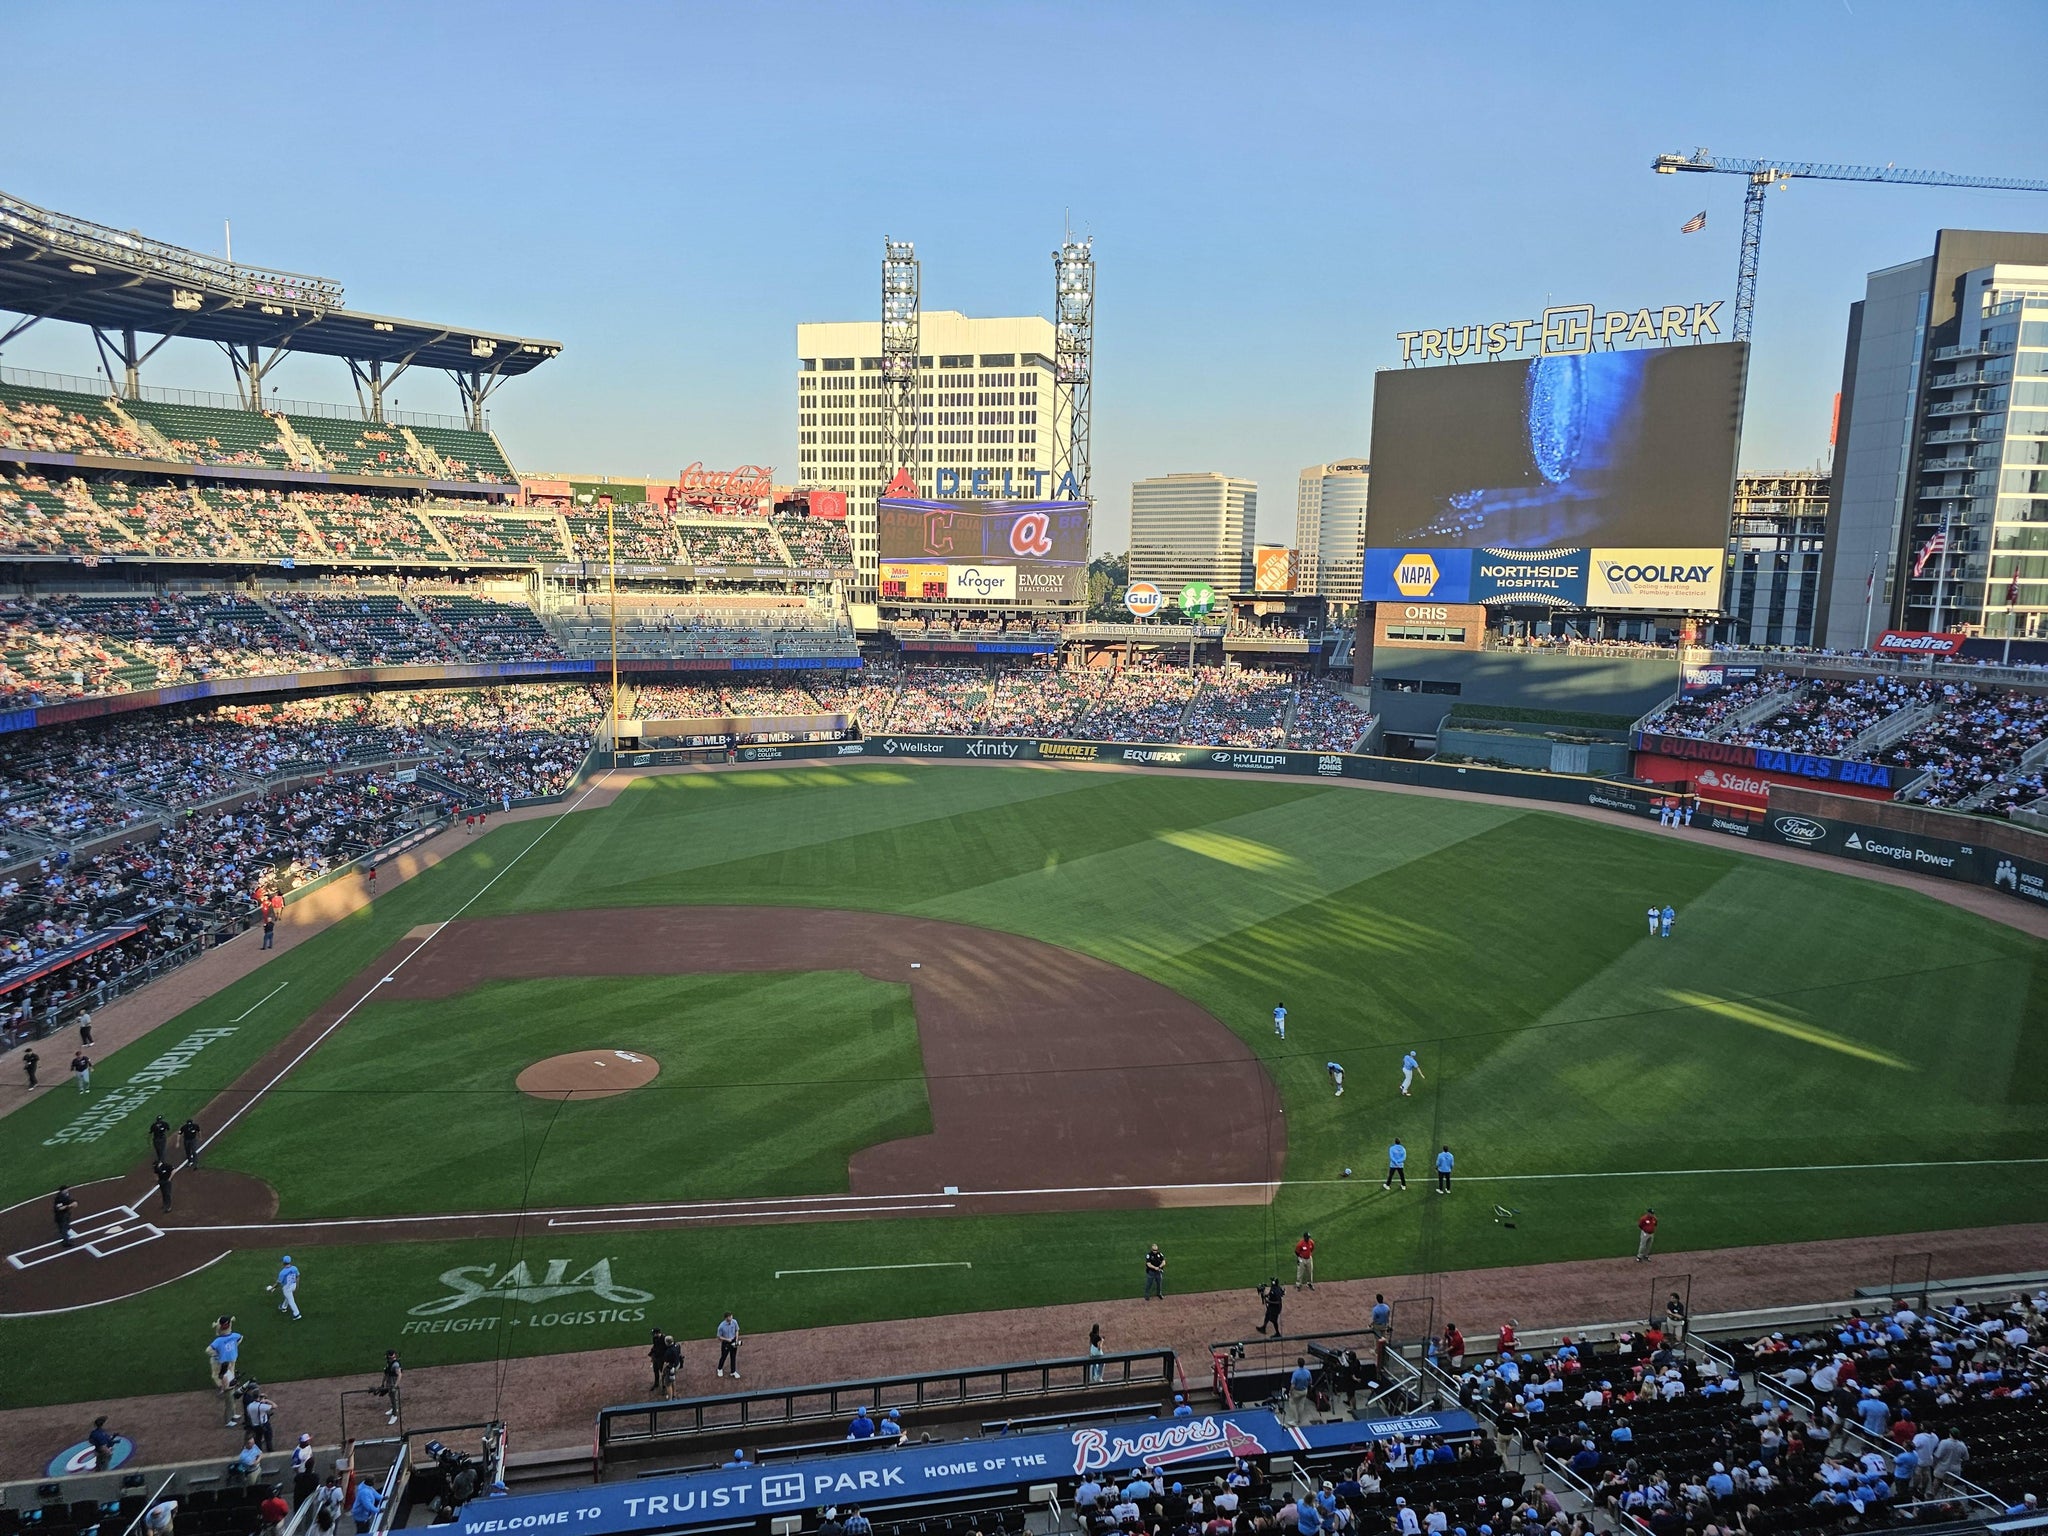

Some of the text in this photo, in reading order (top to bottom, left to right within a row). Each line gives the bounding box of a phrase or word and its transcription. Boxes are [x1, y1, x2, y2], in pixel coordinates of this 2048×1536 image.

[1397, 301, 1725, 361] TRUIST PARK
[936, 468, 1081, 497] DELTA
[1261, 553, 1280, 571] THE
[787, 569, 801, 577] 7:11
[1258, 550, 1298, 590] HOME
[1400, 565, 1432, 585] NAPA
[1480, 566, 1579, 578] NORTHSIDE
[1607, 565, 1714, 583] COOLRAY
[958, 569, 1005, 595] Kroger
[1018, 574, 1066, 586] EMORY
[1496, 579, 1559, 589] HOSPITAL
[1128, 593, 1158, 605] Gulf
[637, 608, 815, 626] HANK AARON TERRACE
[1405, 606, 1448, 620] ORIS
[1880, 634, 1953, 650] RaceTrac
[498, 662, 547, 676] BRAVES
[778, 658, 822, 669] BRAVES
[1686, 669, 1723, 678] BRAVES
[1686, 676, 1723, 685] VISION
[704, 735, 731, 745] MLB+
[768, 733, 795, 743] MLB+
[820, 731, 846, 741] MLB+
[900, 742, 944, 752] Wellstar
[966, 740, 1018, 758] xfinity
[1039, 743, 1098, 756] QUIKRETE
[1123, 749, 1183, 762] EQUIFAX
[1233, 753, 1286, 765] HYUNDAI
[1319, 756, 1342, 765] PAPA
[1317, 763, 1342, 771] JOHNS
[1759, 749, 1832, 778] RAVES
[1839, 759, 1890, 788] BRA
[1719, 820, 1749, 833] National
[1782, 817, 1816, 839] Ford
[1865, 840, 1954, 867] Georgia Power
[407, 1257, 655, 1316] SAIA
[401, 1307, 646, 1335] FREIGHT LOGISTICS
[1373, 1419, 1435, 1434] BRAVES.COM
[465, 1511, 569, 1535] WELCOME
[576, 1507, 602, 1520] TO
[623, 1484, 753, 1518] TRUIST
[814, 1466, 905, 1495] PARK
[924, 1461, 978, 1478] HOME
[985, 1458, 1008, 1471] OF
[1011, 1454, 1047, 1468] THE
[1072, 1416, 1221, 1475] Braves
